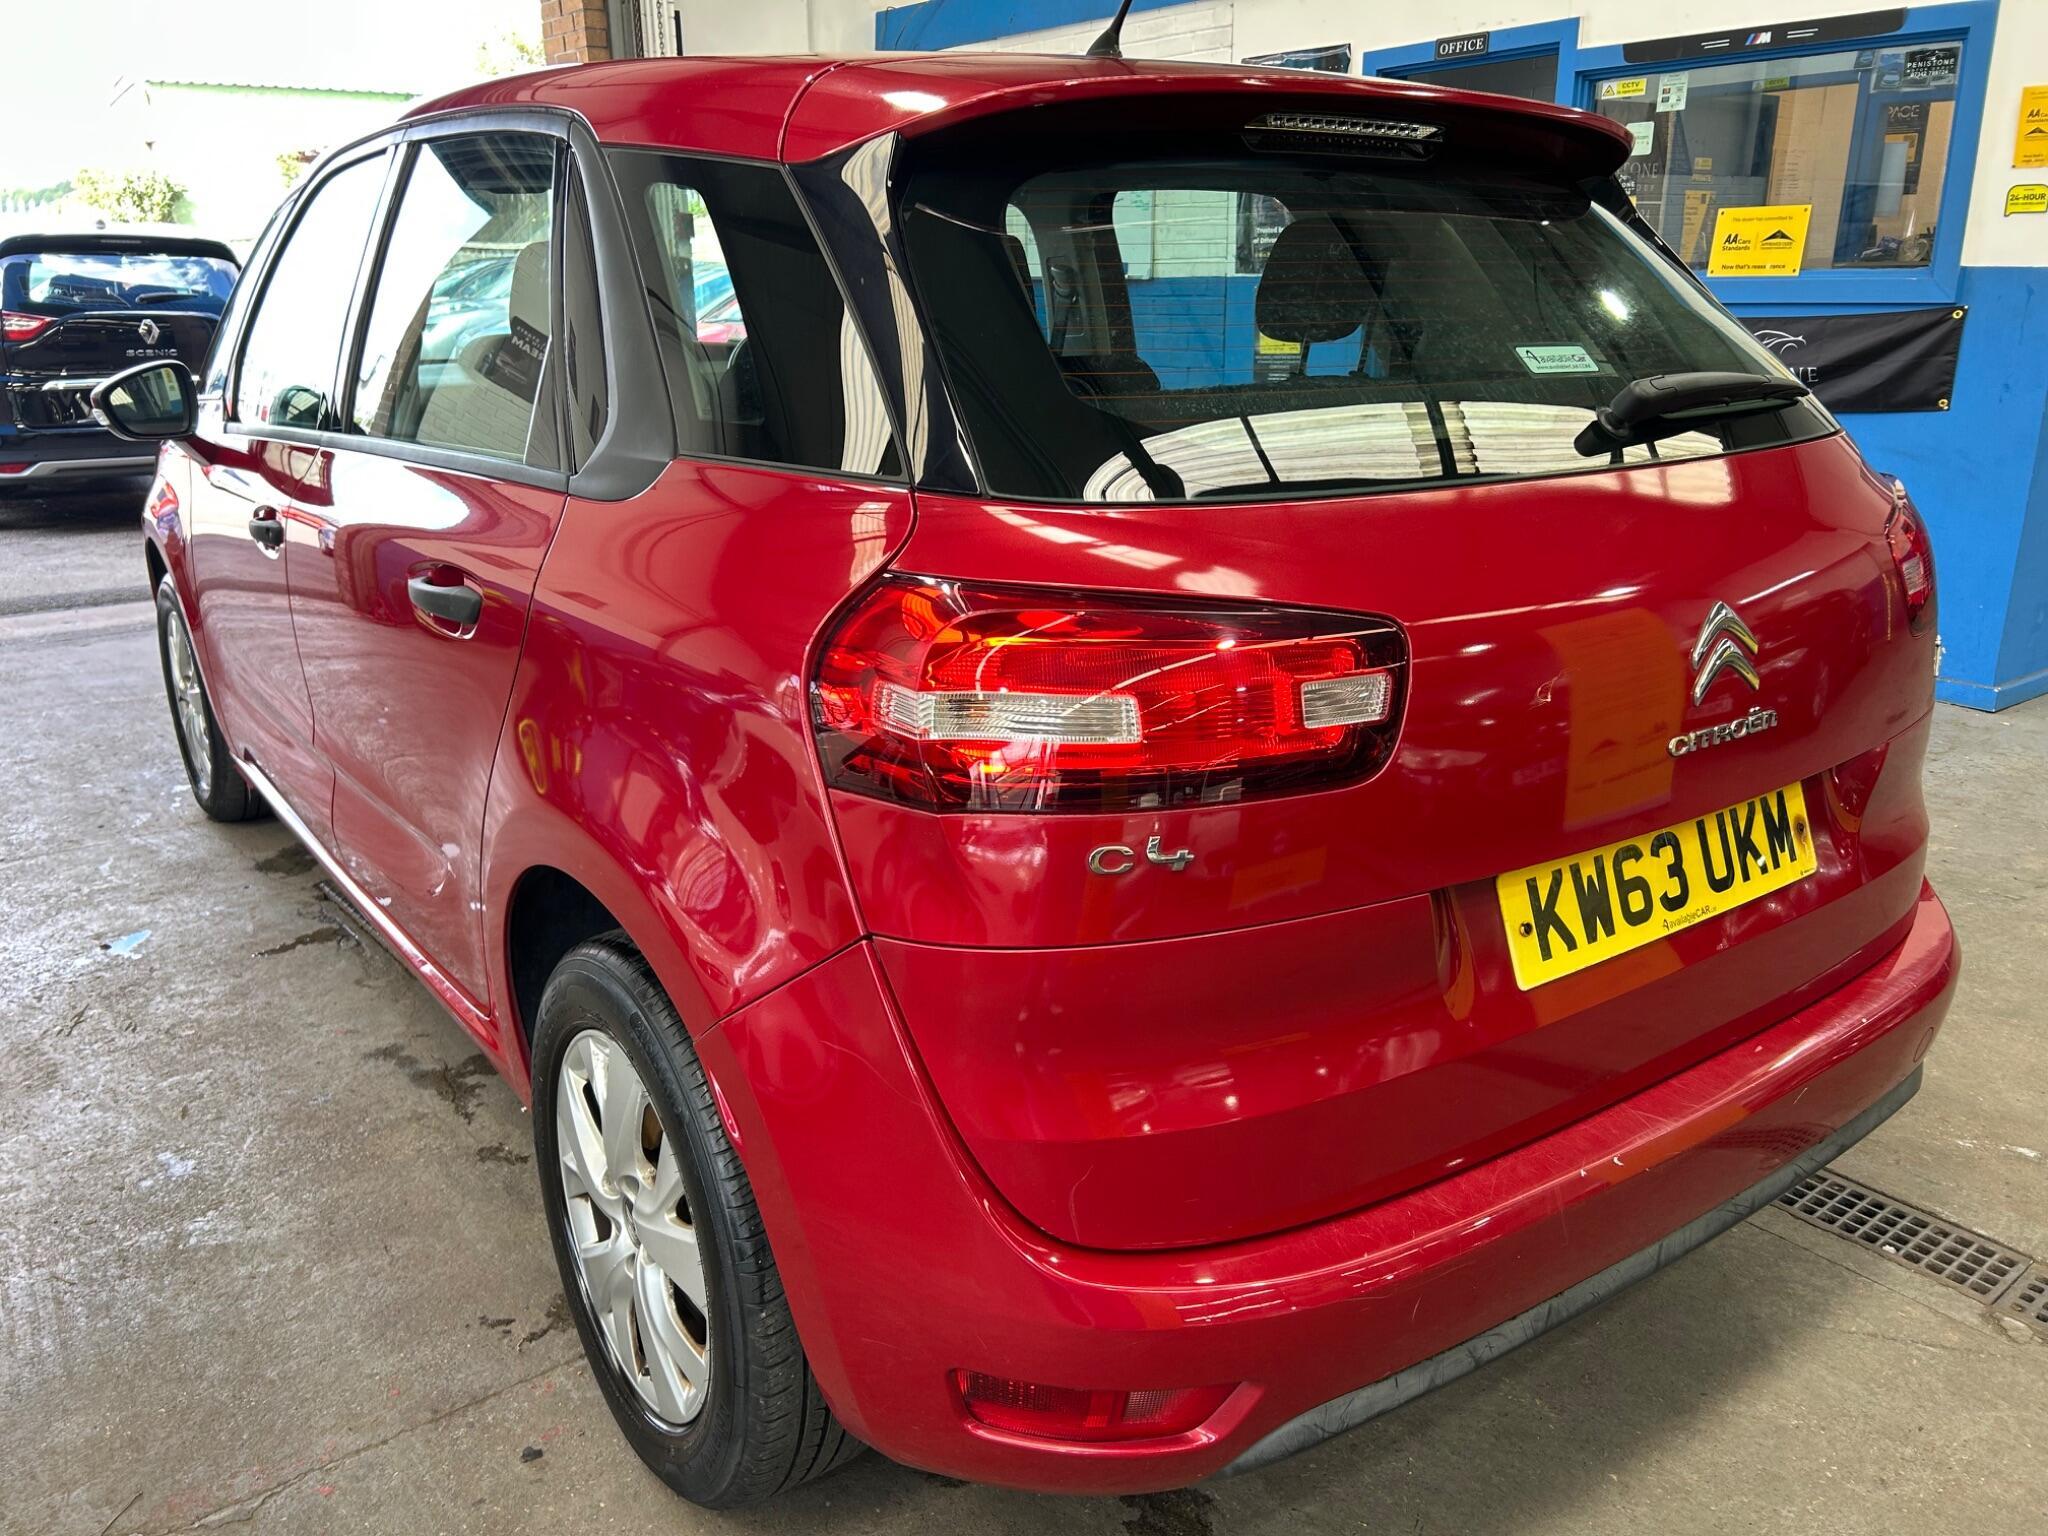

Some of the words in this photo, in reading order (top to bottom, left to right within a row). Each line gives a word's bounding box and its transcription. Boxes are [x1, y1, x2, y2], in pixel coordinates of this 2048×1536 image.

[1439, 38, 1484, 55] OFFICE
[1907, 58, 1955, 69] PENISTONE
[1622, 81, 1641, 89] CCTV
[2027, 109, 2040, 118] AA
[2010, 193, 2046, 202] 24-HOUR
[1723, 233, 1738, 244] AA
[126, 349, 178, 357] SCENIC
[1526, 831, 1690, 962] KW63
[1695, 789, 1798, 894] UKM
